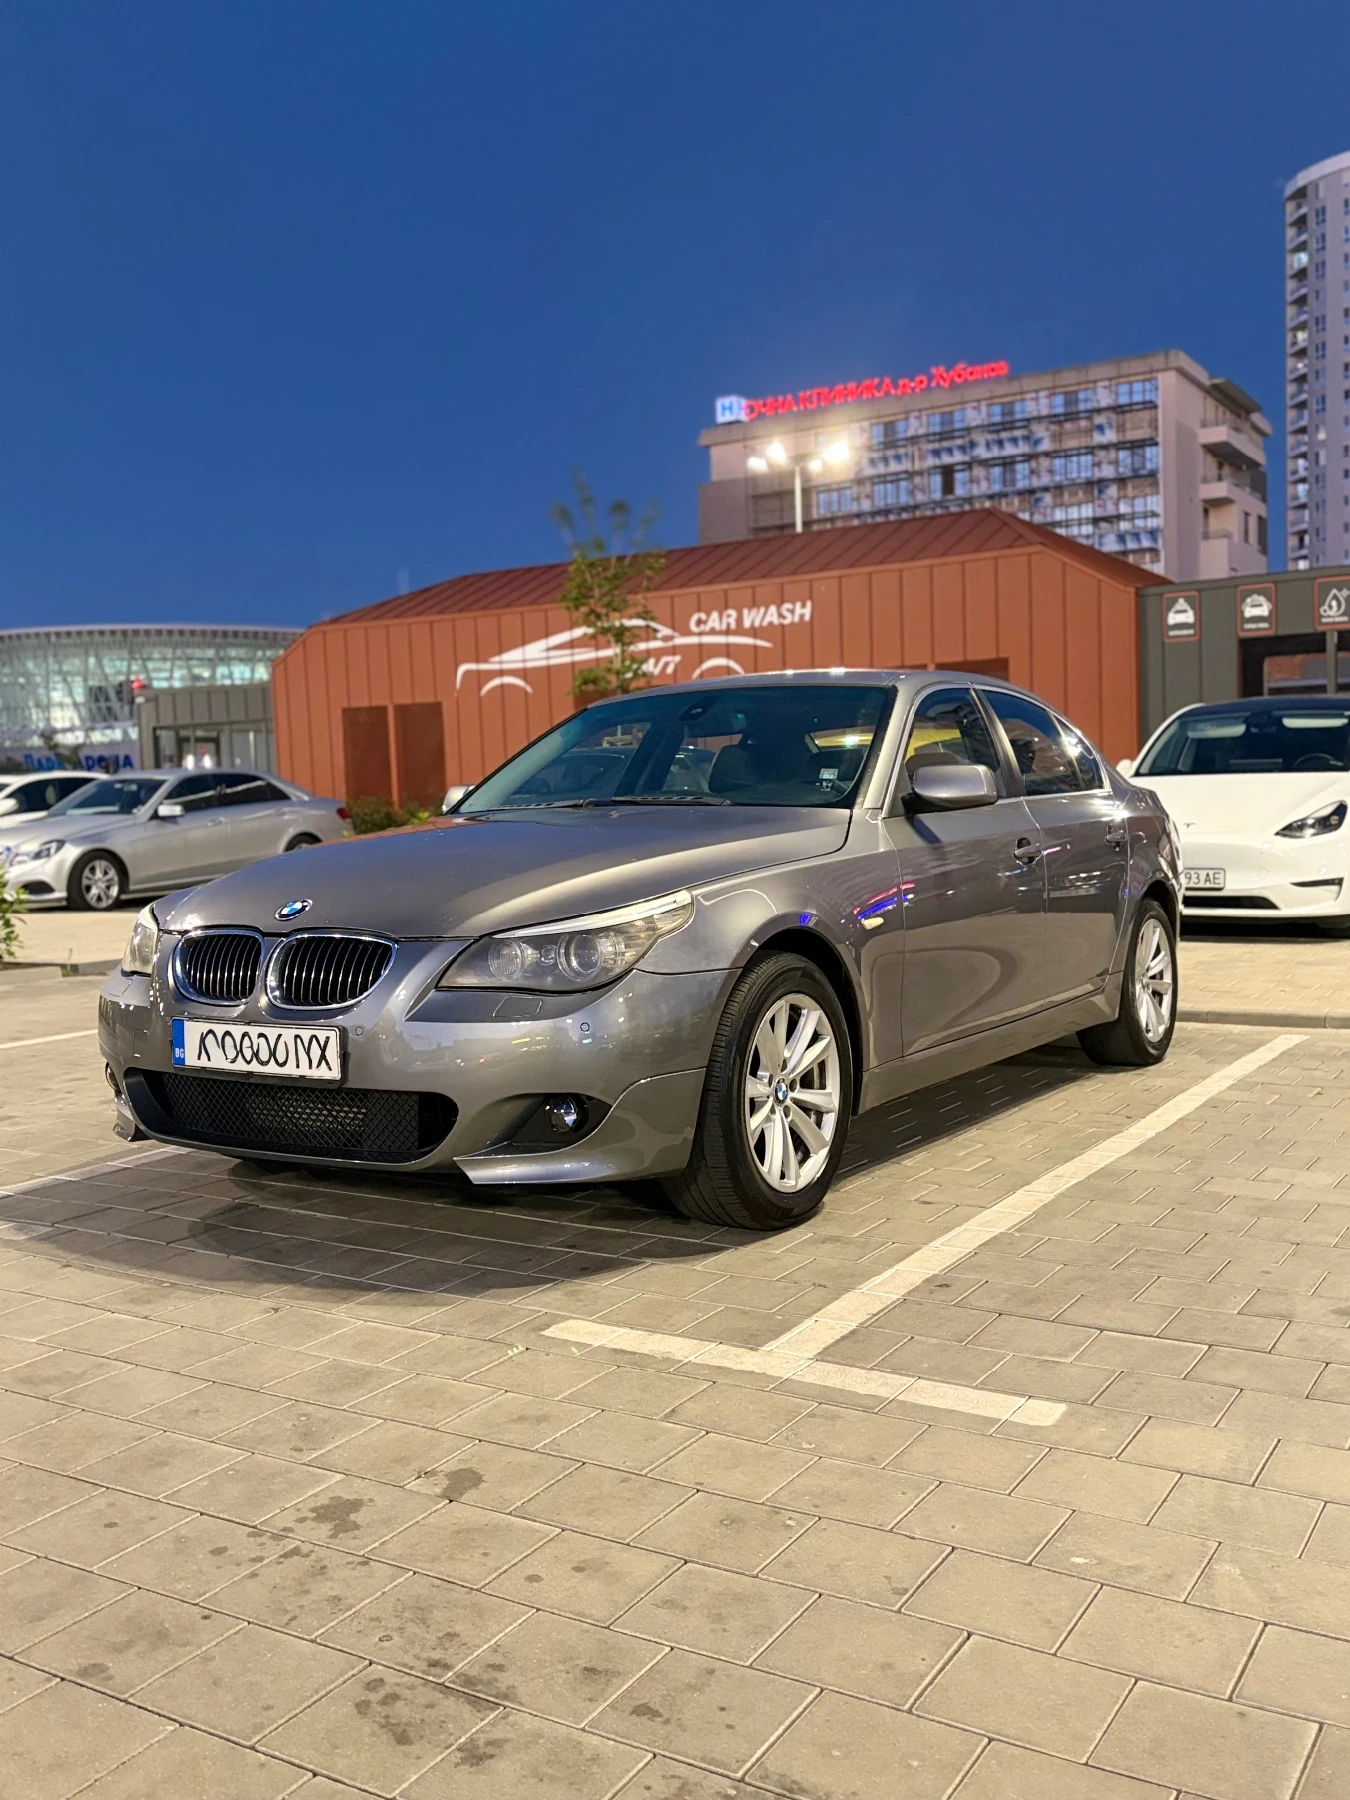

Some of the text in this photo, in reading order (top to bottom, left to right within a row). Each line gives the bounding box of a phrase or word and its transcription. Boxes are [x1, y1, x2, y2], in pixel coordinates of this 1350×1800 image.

[743, 395, 798, 421] ОЧНА
[798, 377, 896, 410] КЛИНИКА
[689, 599, 812, 633] CAR WASH
[1184, 871, 1221, 885] 93 AE
[175, 1047, 185, 1058] BG
